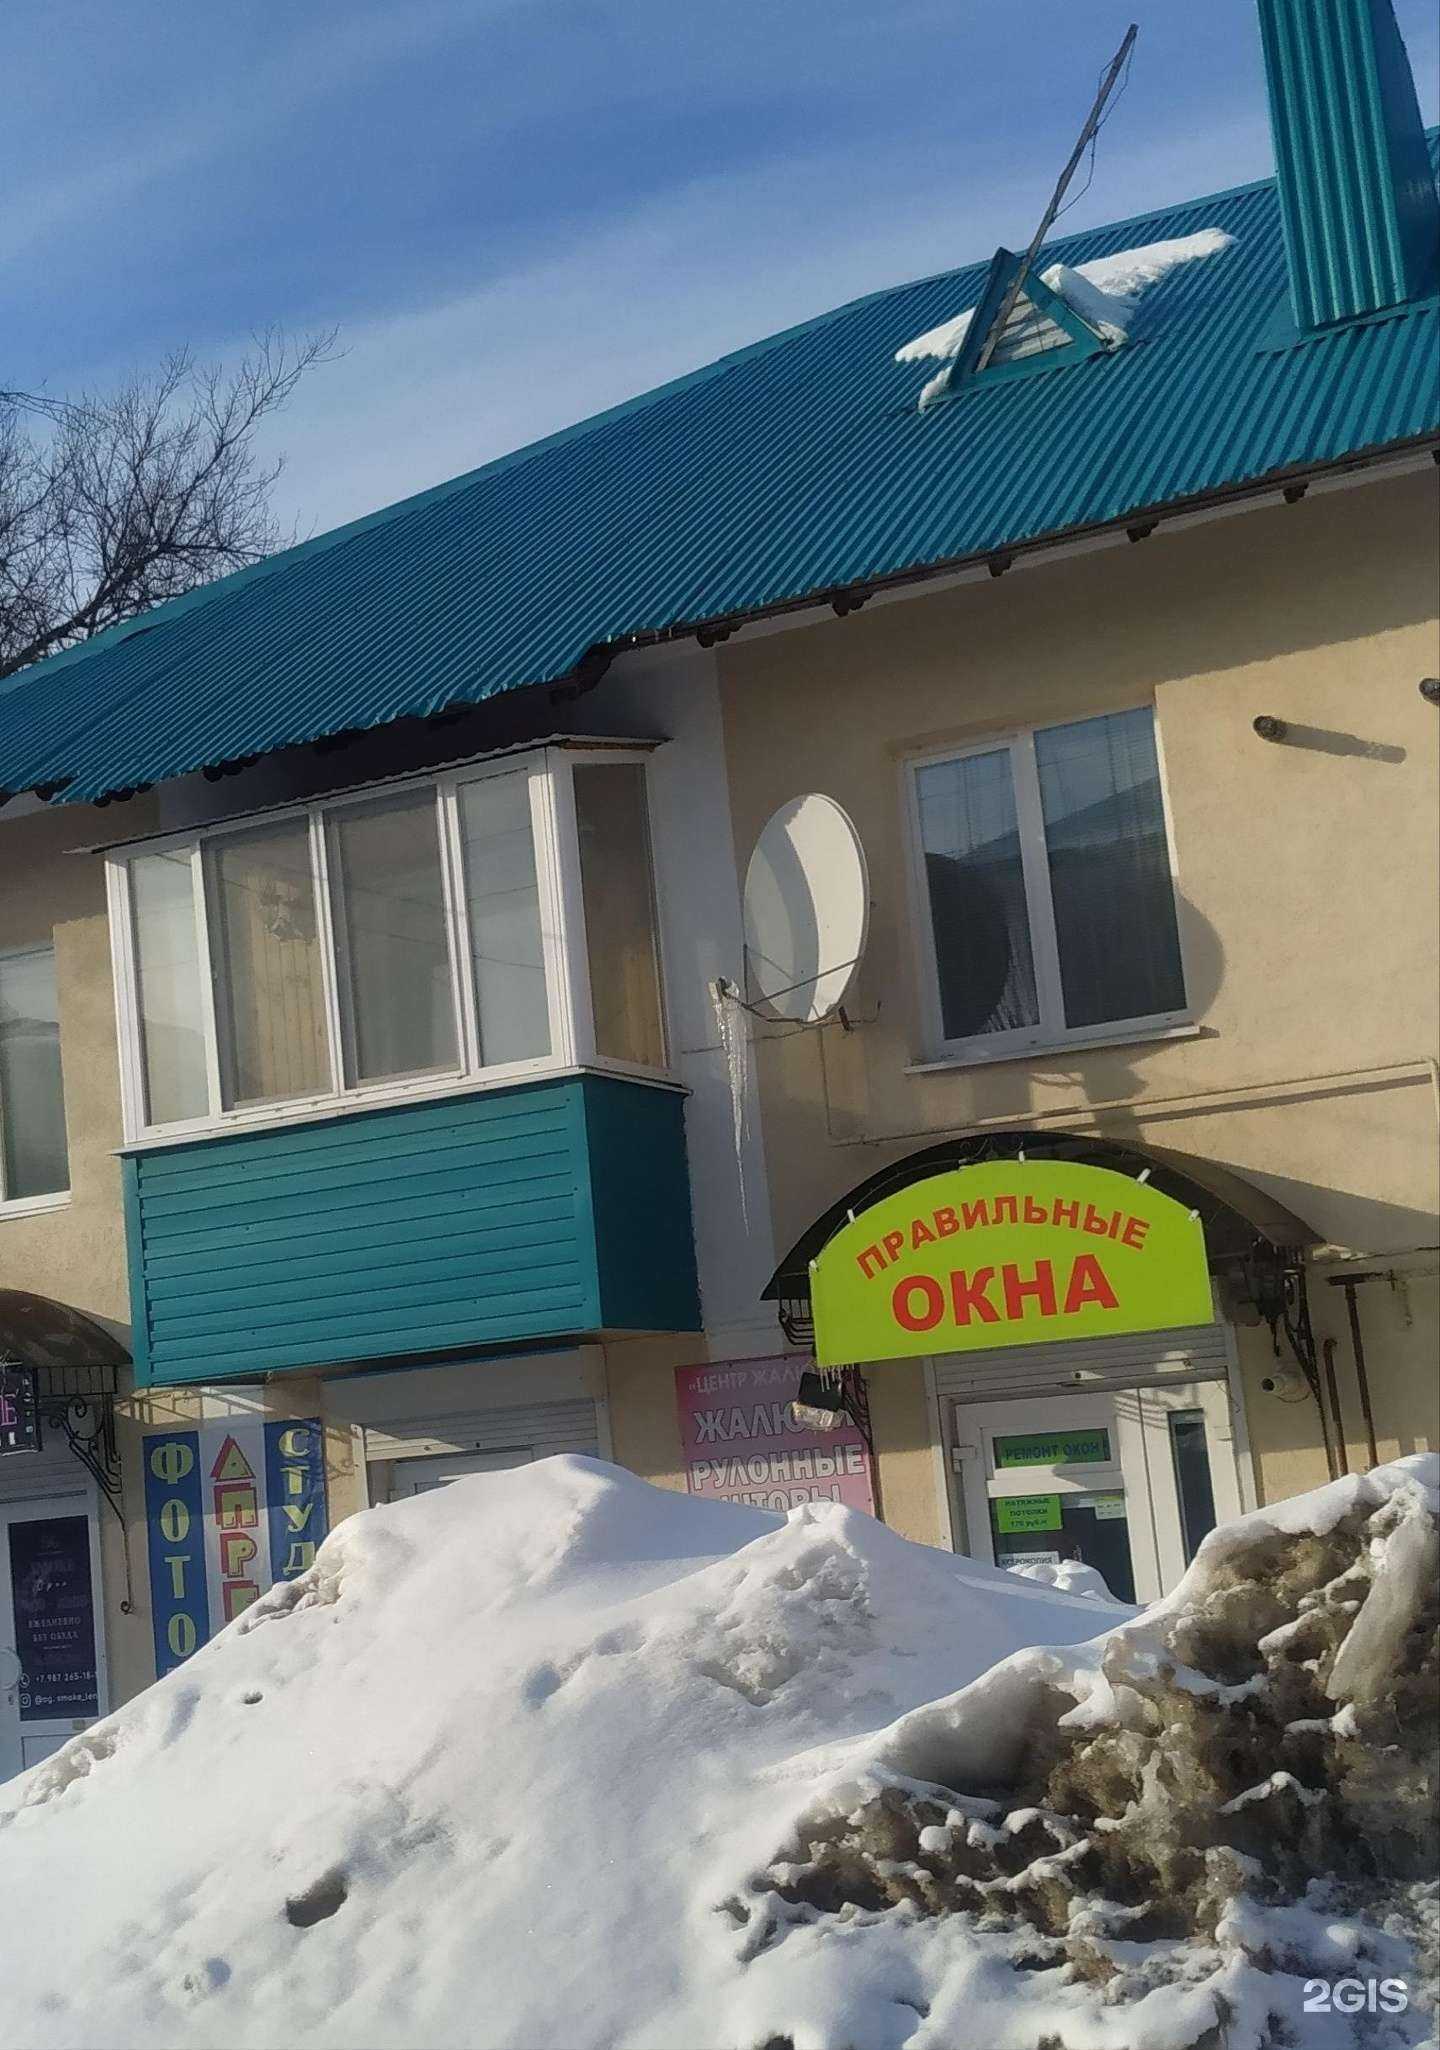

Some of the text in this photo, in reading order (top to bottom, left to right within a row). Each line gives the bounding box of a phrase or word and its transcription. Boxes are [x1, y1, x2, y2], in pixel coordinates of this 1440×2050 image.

[855, 1194, 1152, 1281] ПРАВИЛЬНЫЕ
[891, 1252, 1120, 1333] ОКНА
[689, 1443, 867, 1492] РУЛОННЫЕ
[1004, 1441, 1101, 1461] РЕМОНТ ОКОН
[1009, 1507, 1048, 1518] ПОТОЛКИ
[150, 1442, 196, 1658] ФОТО
